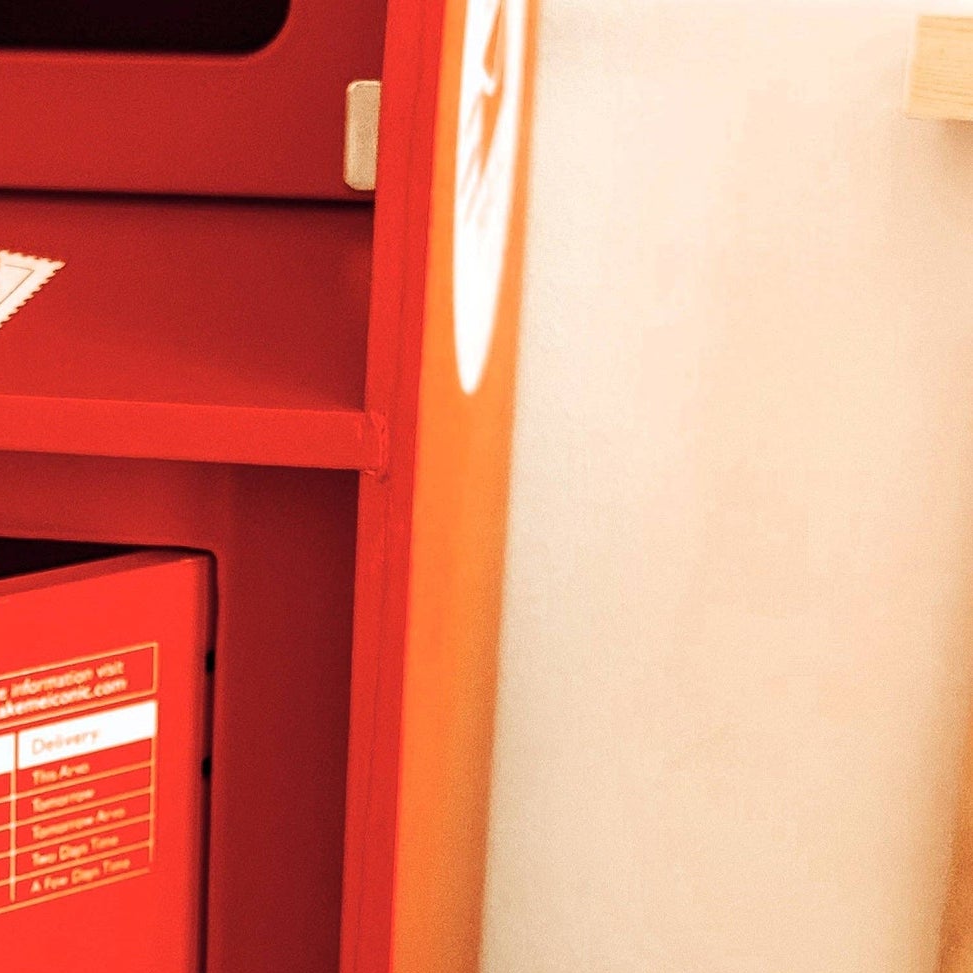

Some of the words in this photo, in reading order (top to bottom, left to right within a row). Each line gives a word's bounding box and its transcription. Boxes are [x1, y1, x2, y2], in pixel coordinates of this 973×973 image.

[10, 669, 95, 699] information
[95, 660, 125, 679] visit
[31, 729, 100, 755] Delivery
